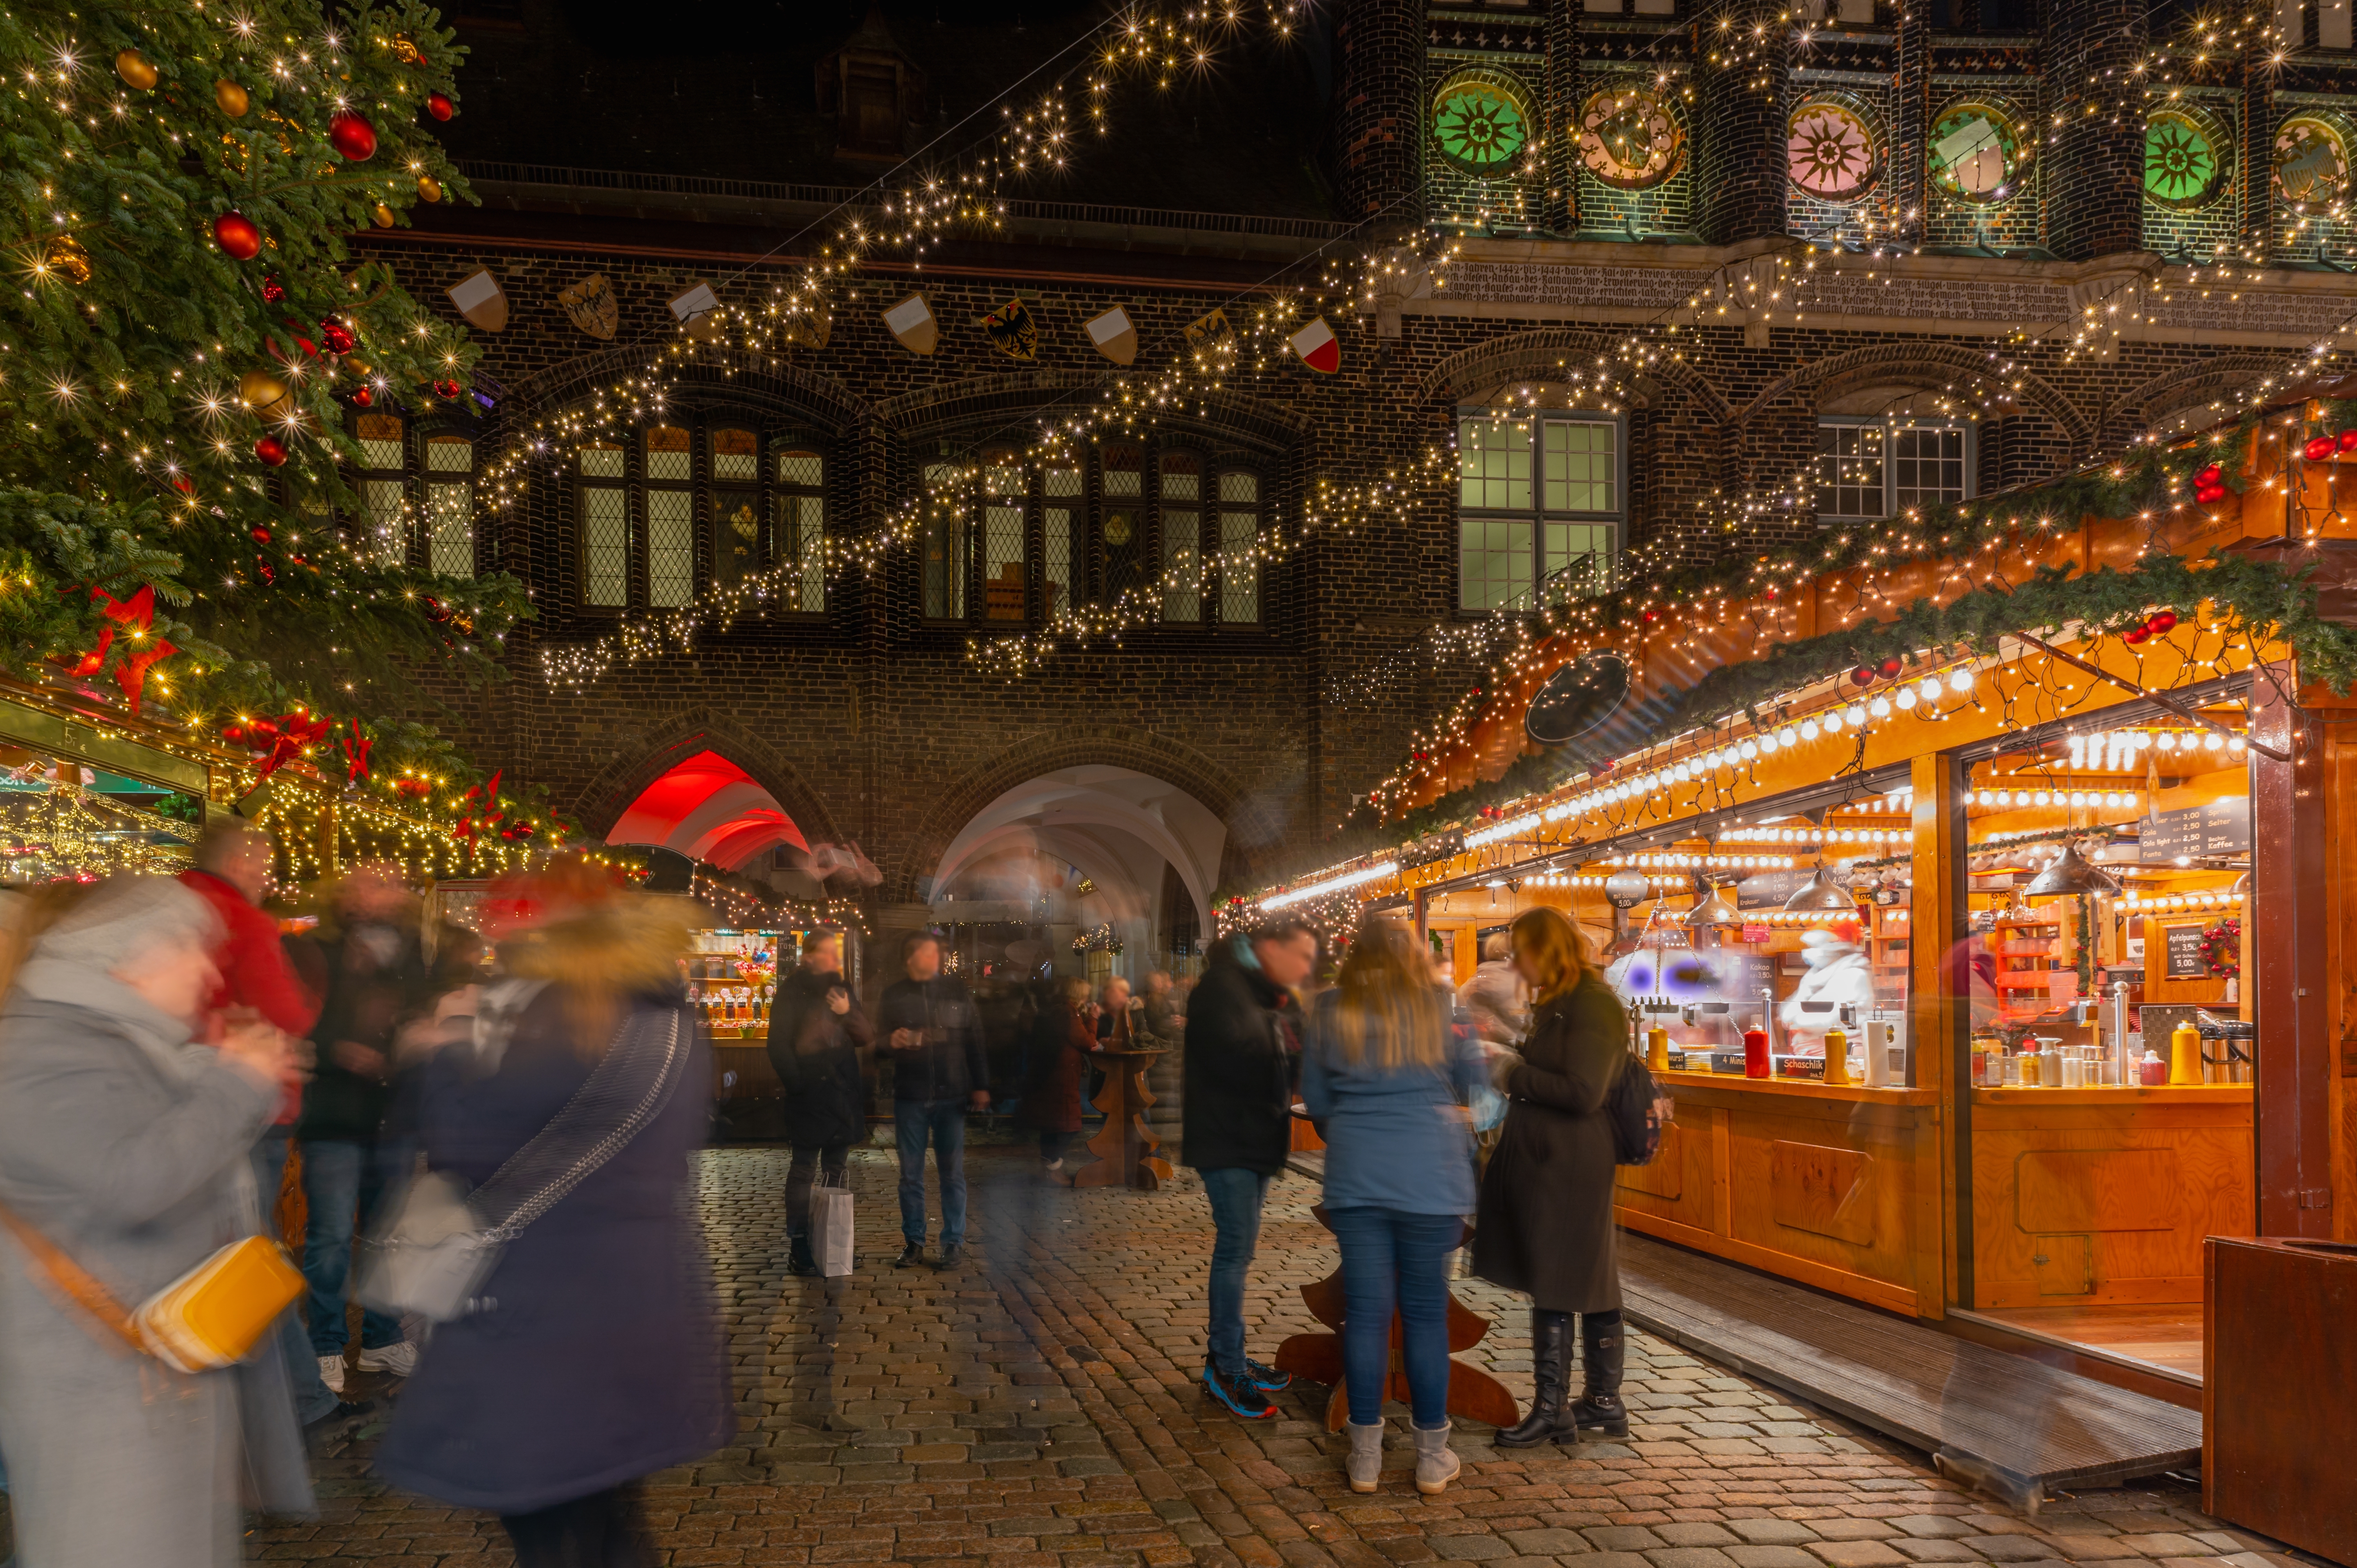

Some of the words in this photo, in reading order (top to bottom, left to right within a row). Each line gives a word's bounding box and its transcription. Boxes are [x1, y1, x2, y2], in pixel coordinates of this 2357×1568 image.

[1464, 263, 1495, 273] Jahren
[1499, 264, 1519, 274] 1442
[1524, 264, 1537, 274] bis
[1541, 265, 1560, 275] 1444
[1565, 264, 1579, 275] hat
[1584, 267, 1597, 276] der
[1601, 267, 1616, 277] Rat
[1620, 268, 1633, 278] der
[1639, 269, 1666, 279] Freien
[1463, 273, 1488, 282] diesen
[1492, 274, 1520, 283] Anbau
[1525, 274, 1537, 284] des
[1542, 275, 1582, 285] Rathauses
[1587, 277, 1599, 287] zur
[1603, 276, 1653, 289] Erweiterung
[1658, 278, 1671, 288] der
[1820, 275, 1833, 284] bis
[1837, 277, 1856, 287] 1612
[1890, 278, 1912, 288] dieser
[1916, 279, 1942, 290] Flügel
[1947, 281, 1989, 292] umgebaut
[1994, 283, 2010, 293] und
[2014, 283, 2040, 294] erhielt
[2044, 285, 2068, 295] damit
[1449, 281, 1480, 292] Langen
[1485, 283, 1514, 293] Hauses
[1519, 283, 1537, 293] oder
[1600, 287, 1637, 297] errichten
[1820, 285, 1851, 295] heutige
[1967, 292, 1994, 301] wurde
[1998, 293, 2011, 302] als
[2015, 293, 2052, 304] Festraum
[2056, 294, 2068, 305] des
[1431, 291, 1472, 301] Gewölben
[1477, 292, 1489, 301] des
[1493, 293, 1535, 303] Neubaues
[1539, 294, 1562, 304] ward
[1566, 294, 1579, 304] die
[1638, 297, 1650, 307] der
[1654, 298, 1675, 308] Stadt
[1821, 295, 1837, 304] von
[1841, 296, 1869, 306] Meister
[1875, 296, 1905, 307] Tönnies
[1909, 298, 1933, 309] Evers
[1953, 300, 1967, 310] mit
[1971, 301, 2020, 312] kunstvollem
[2023, 303, 2072, 314] Schnitzwerk
[2256, 293, 2264, 302] in
[2269, 294, 2292, 303] einem
[2296, 295, 2346, 306] Nebenraume
[1850, 306, 1884, 316] zugleich
[1888, 307, 1901, 316] die
[1906, 308, 1934, 318] Treppe
[1955, 310, 1968, 319] der
[1973, 310, 2003, 320] Breiten
[2007, 312, 2037, 322] Straße
[2041, 313, 2070, 323] erbaut
[2203, 300, 2214, 310] des
[2244, 301, 2277, 312] Deshalb
[2281, 305, 2307, 314] erhielt
[2311, 305, 2335, 315] später
[2170, 309, 2186, 319] den
[2189, 310, 2220, 319] Namen
[2309, 314, 2322, 323] den
[2172, 318, 2188, 327] Bau
[2191, 320, 2217, 329] außen
[2221, 321, 2237, 330] und
[2241, 322, 2265, 330] innen
[2183, 812, 2199, 821] 3,00
[2208, 807, 2231, 816] Sprite
[2183, 822, 2200, 831] 2,50
[2157, 838, 2170, 846] light
[2183, 834, 2200, 842] 2,50
[2183, 845, 2200, 854] 2,50
[2208, 841, 2234, 850] Kaffee
[1833, 876, 1847, 884] 4,00
[2169, 933, 2201, 944] Apfelpunsch
[2182, 943, 2197, 952] 3,50
[1784, 1059, 1823, 1069] Schaschlik
